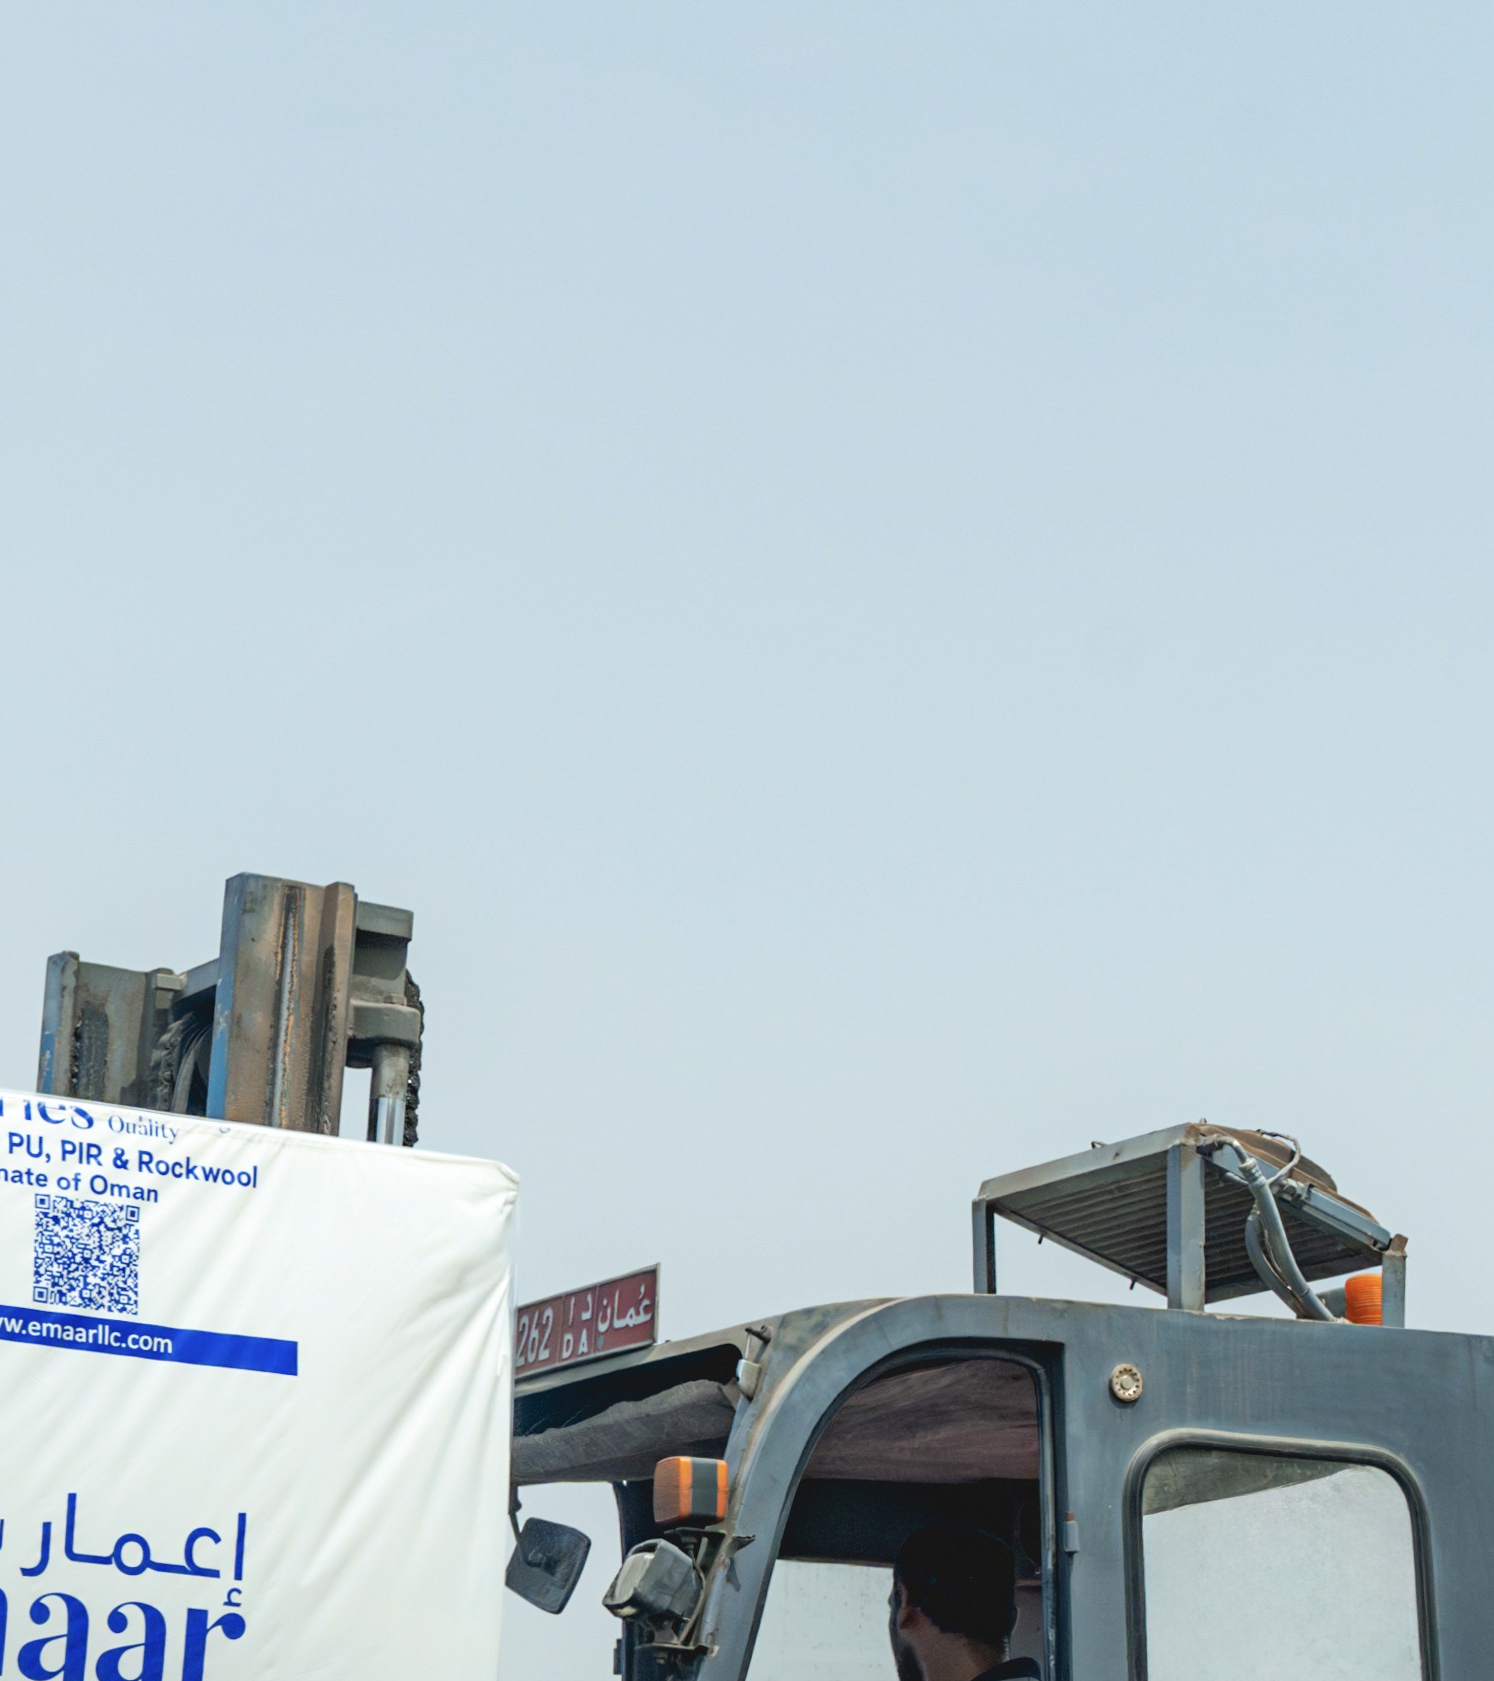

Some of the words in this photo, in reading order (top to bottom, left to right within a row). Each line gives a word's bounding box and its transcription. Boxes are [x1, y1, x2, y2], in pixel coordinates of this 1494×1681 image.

[6, 1130, 51, 1164] PU,
[60, 1138, 103, 1167] PIR
[112, 1145, 130, 1171] &
[138, 1149, 257, 1188] Rockwool
[56, 1171, 81, 1193] of
[89, 1173, 159, 1203] Oman
[19, 1492, 247, 1607] إعمار
